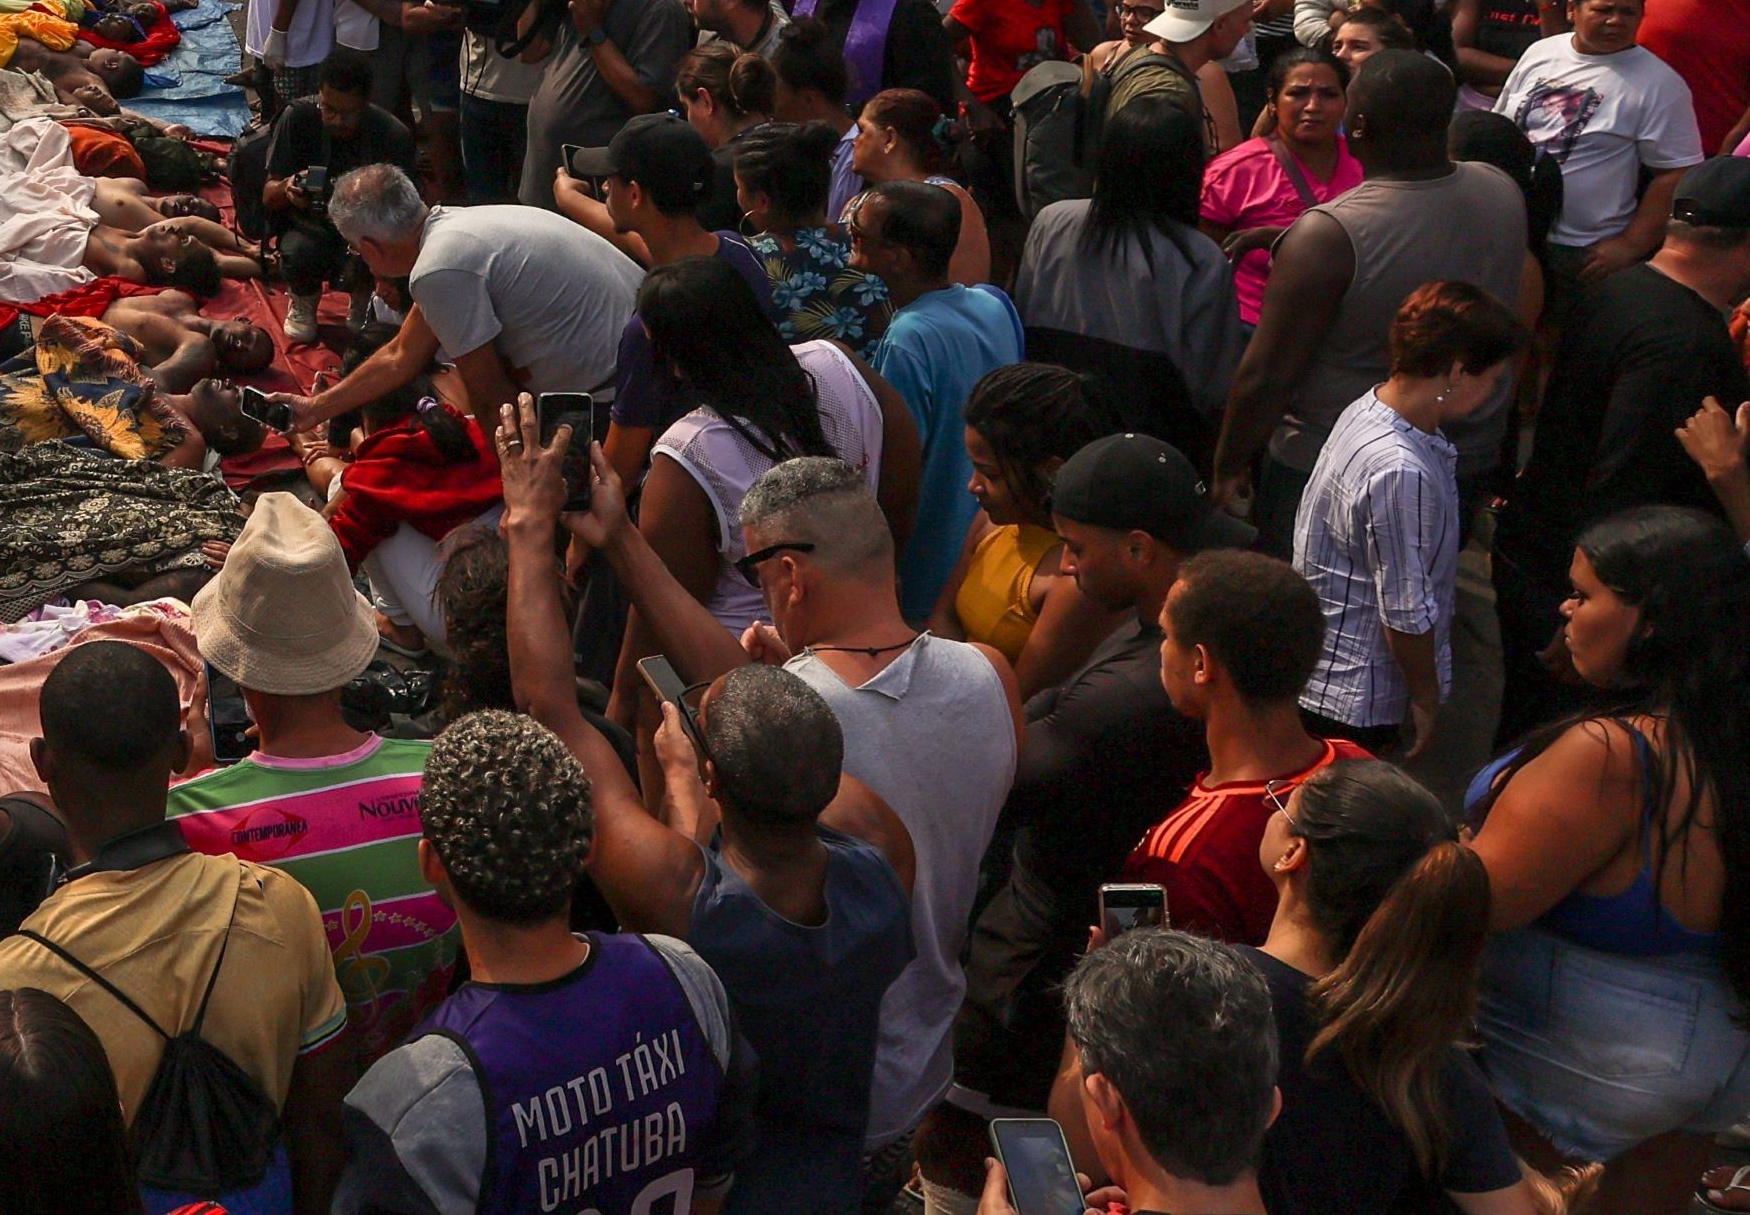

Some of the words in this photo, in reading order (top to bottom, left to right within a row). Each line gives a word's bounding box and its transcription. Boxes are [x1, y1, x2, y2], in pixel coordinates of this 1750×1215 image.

[511, 1066, 613, 1149] MOTO
[615, 1028, 686, 1102] TÁXI
[538, 1101, 687, 1212] CHATUBA
